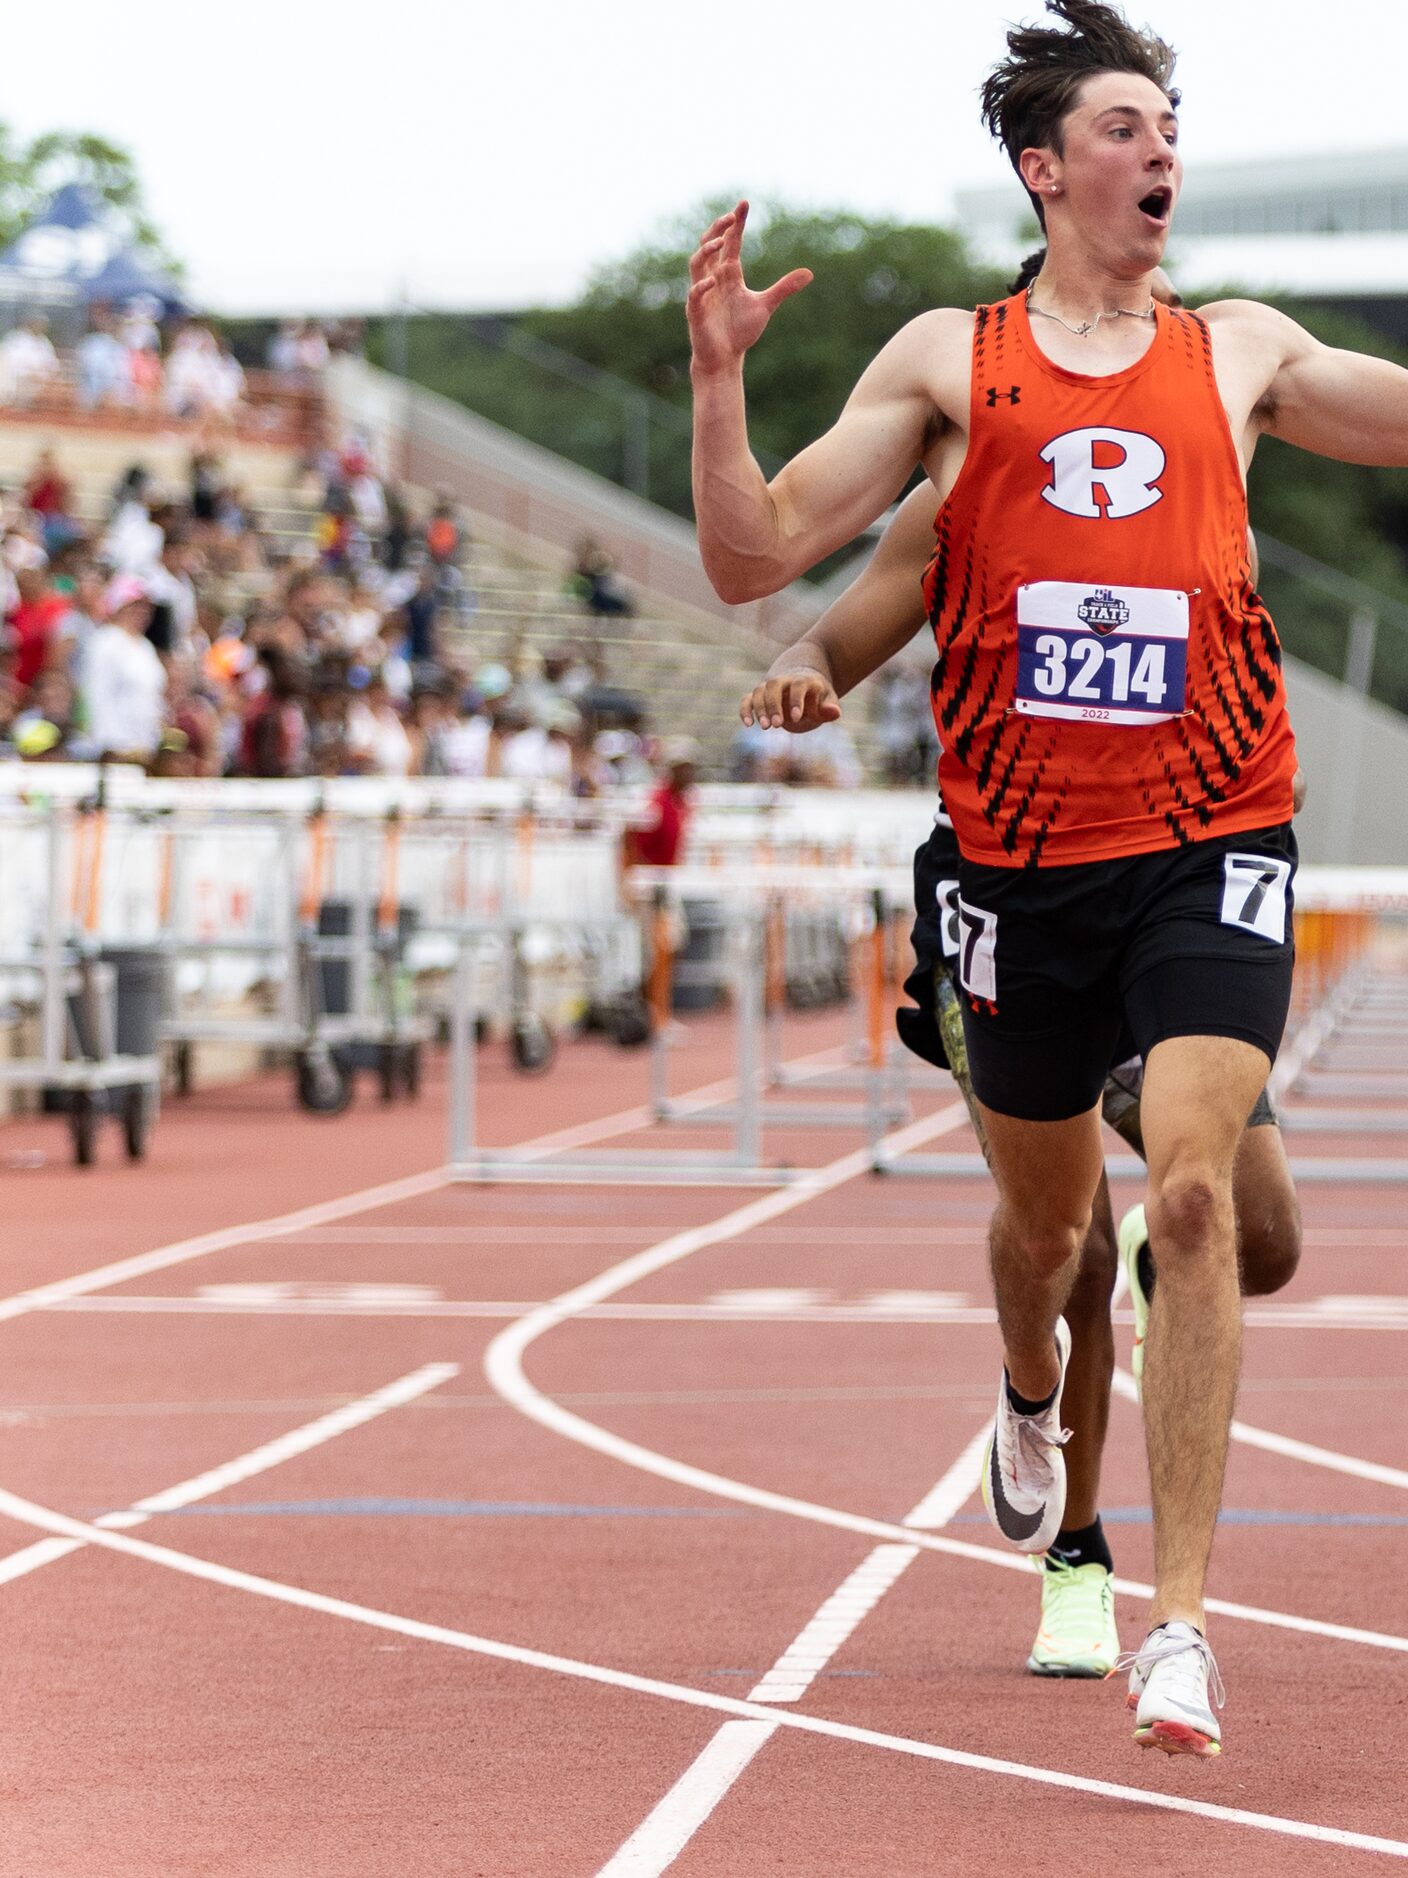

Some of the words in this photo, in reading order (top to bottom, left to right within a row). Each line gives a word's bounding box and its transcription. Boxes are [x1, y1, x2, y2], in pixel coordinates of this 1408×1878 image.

[1039, 425, 1166, 519] R
[1079, 605, 1128, 620] STATE
[1034, 634, 1167, 704] 3214
[1081, 709, 1110, 720] 2022
[1232, 859, 1280, 925] 7
[960, 907, 986, 986] 7
